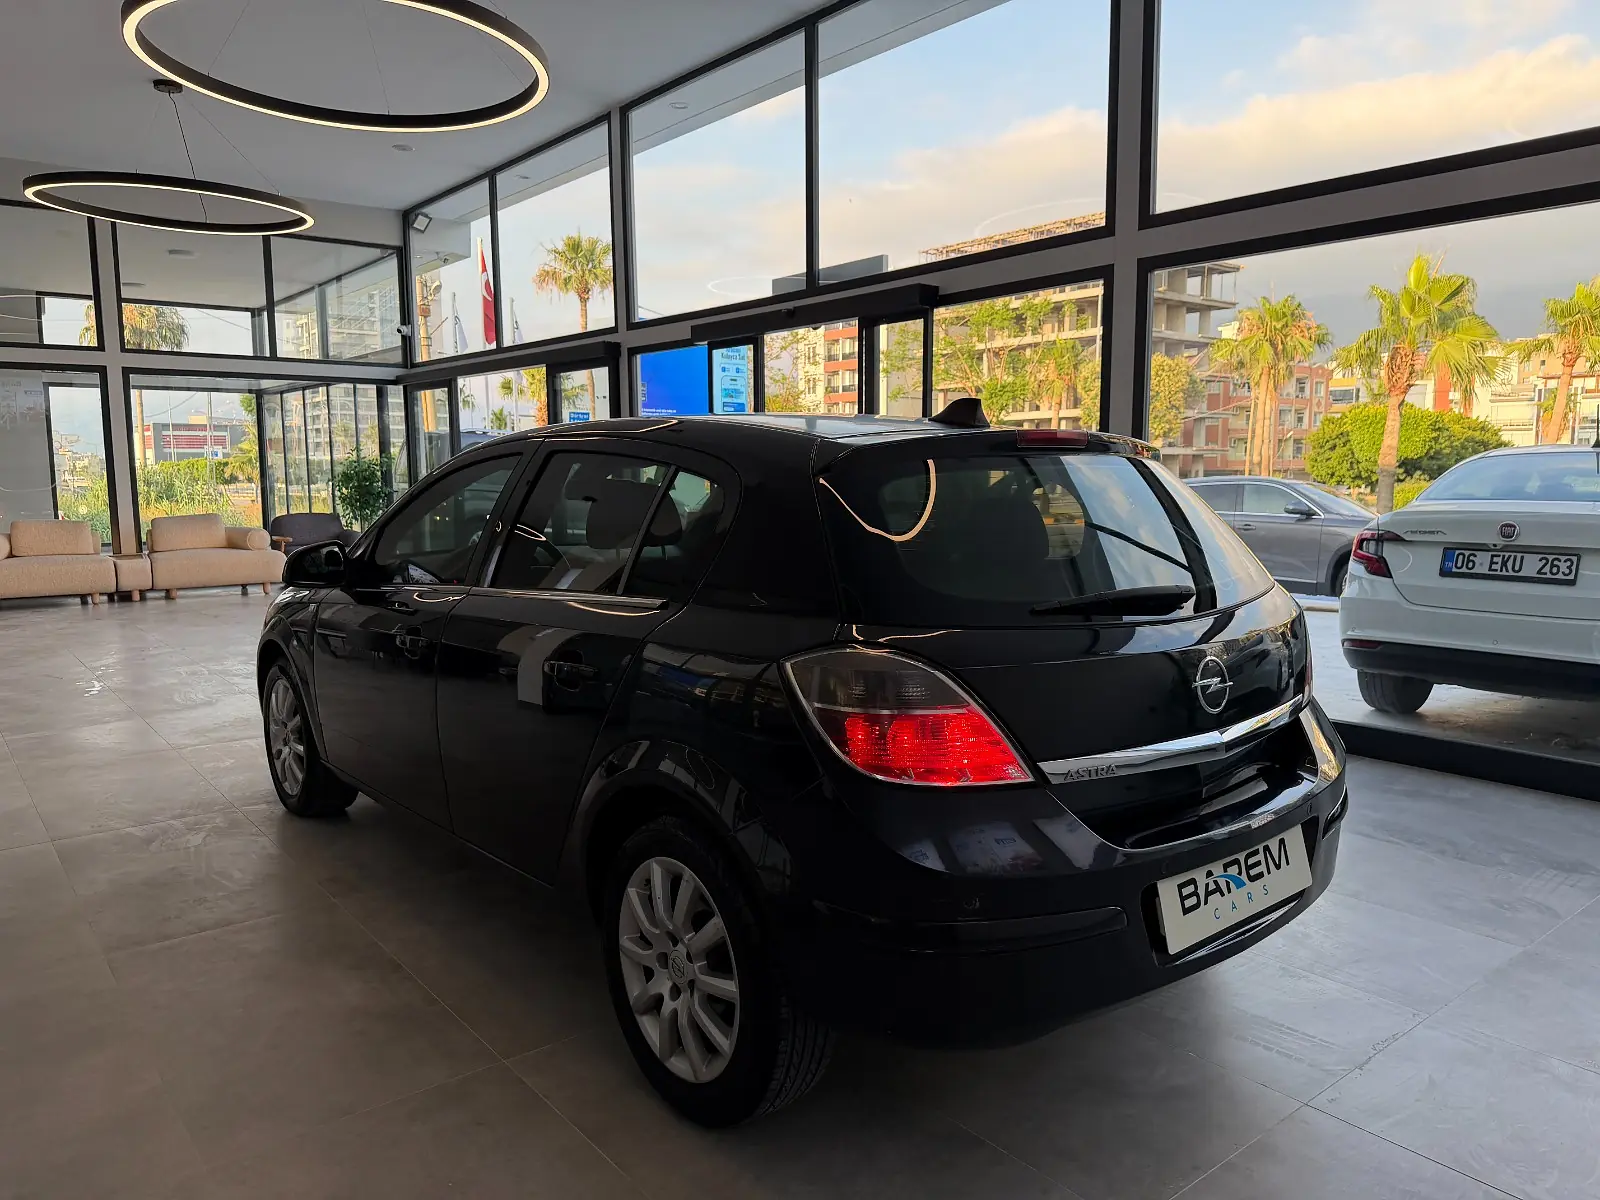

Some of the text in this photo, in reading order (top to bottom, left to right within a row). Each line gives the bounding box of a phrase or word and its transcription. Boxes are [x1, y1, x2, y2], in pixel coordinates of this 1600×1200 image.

[1454, 552, 1478, 571] 06
[1488, 553, 1525, 574] EKU
[1536, 556, 1575, 577] 263
[1063, 763, 1118, 781] ASTRA
[1176, 837, 1290, 916] BAREM
[1213, 884, 1270, 920] CARS
